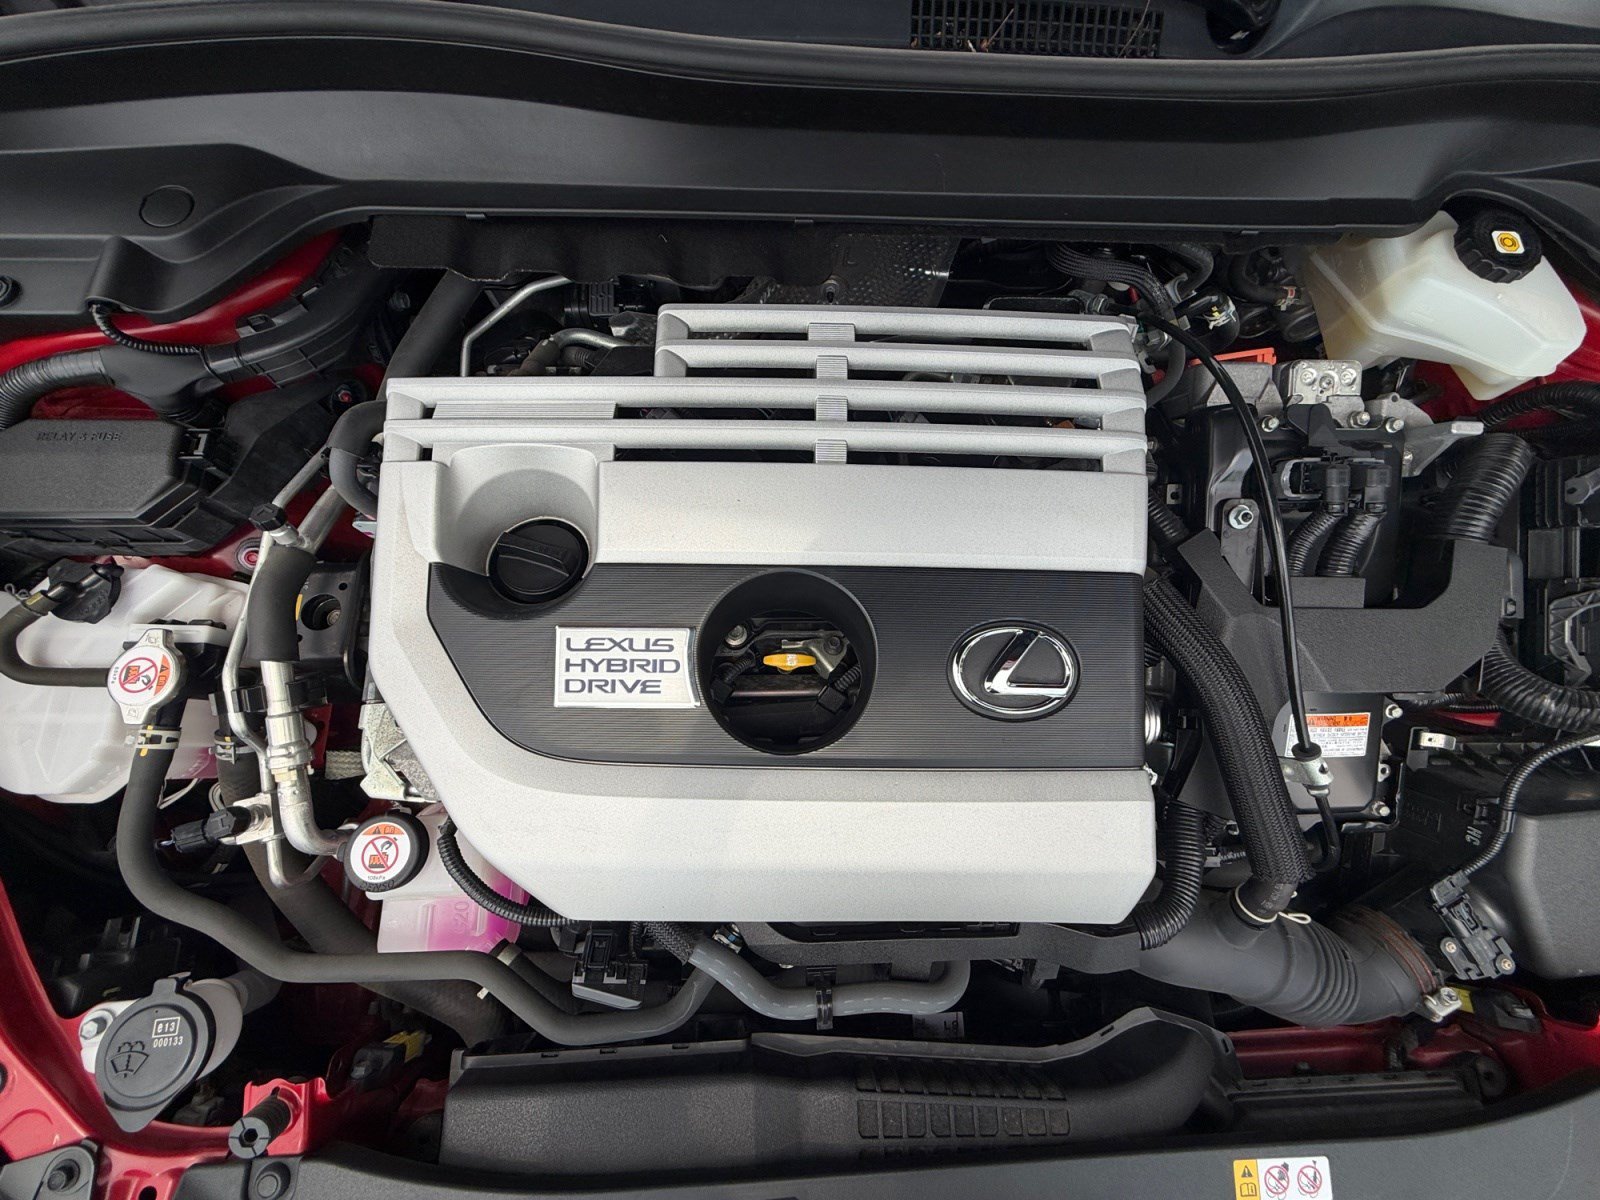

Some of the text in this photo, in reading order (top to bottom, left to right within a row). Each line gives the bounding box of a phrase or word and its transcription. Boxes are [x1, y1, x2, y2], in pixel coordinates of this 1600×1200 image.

[565, 637, 675, 653] LEXUS
[564, 658, 681, 674] HYBRID
[564, 679, 662, 694] DRIVE
[360, 879, 395, 891] DENSO
[153, 1036, 184, 1048] 000133
